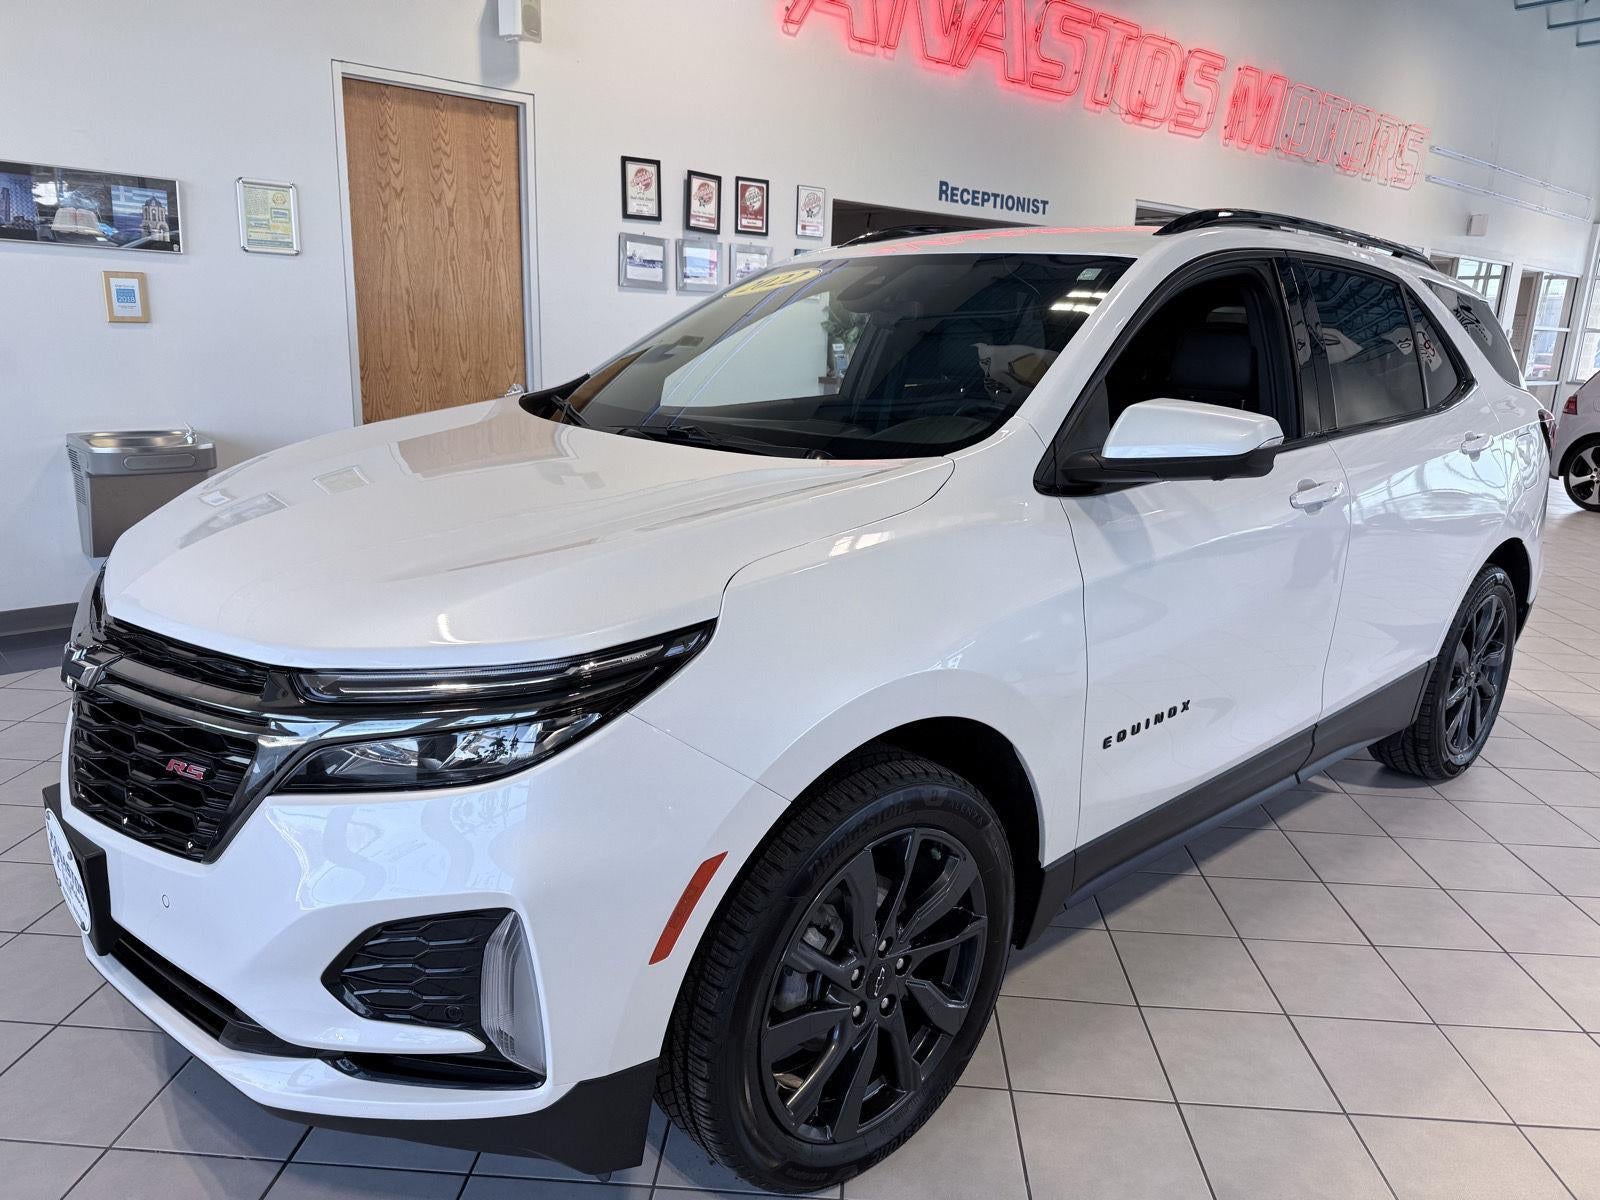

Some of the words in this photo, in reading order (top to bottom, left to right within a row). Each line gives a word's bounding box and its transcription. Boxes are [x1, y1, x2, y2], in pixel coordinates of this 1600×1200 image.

[1224, 65, 1431, 189] MOTORS
[938, 180, 1049, 215] RECEPTIONIST
[117, 295, 136, 304] 2018
[1102, 699, 1191, 750] EQUINOX
[165, 758, 207, 782] RS
